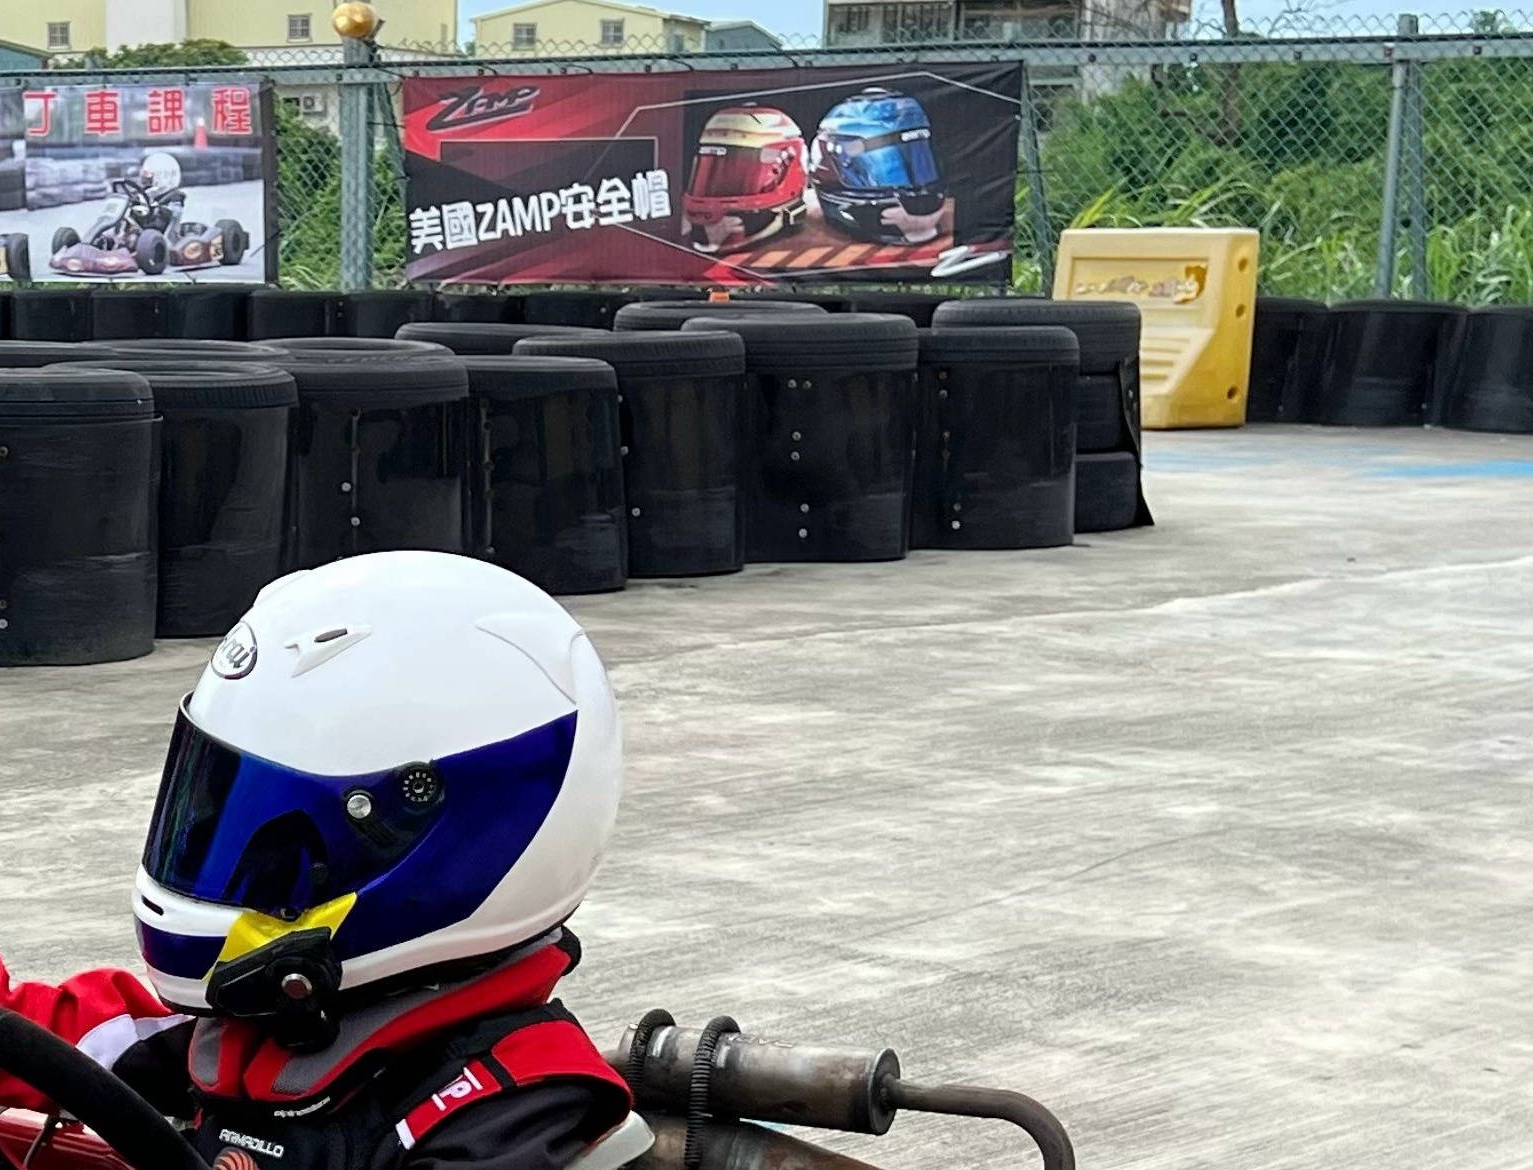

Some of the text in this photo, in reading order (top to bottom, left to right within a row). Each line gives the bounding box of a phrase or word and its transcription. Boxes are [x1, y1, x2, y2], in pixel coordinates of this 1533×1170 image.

[408, 169, 672, 255] 美國ZAMP安全帽
